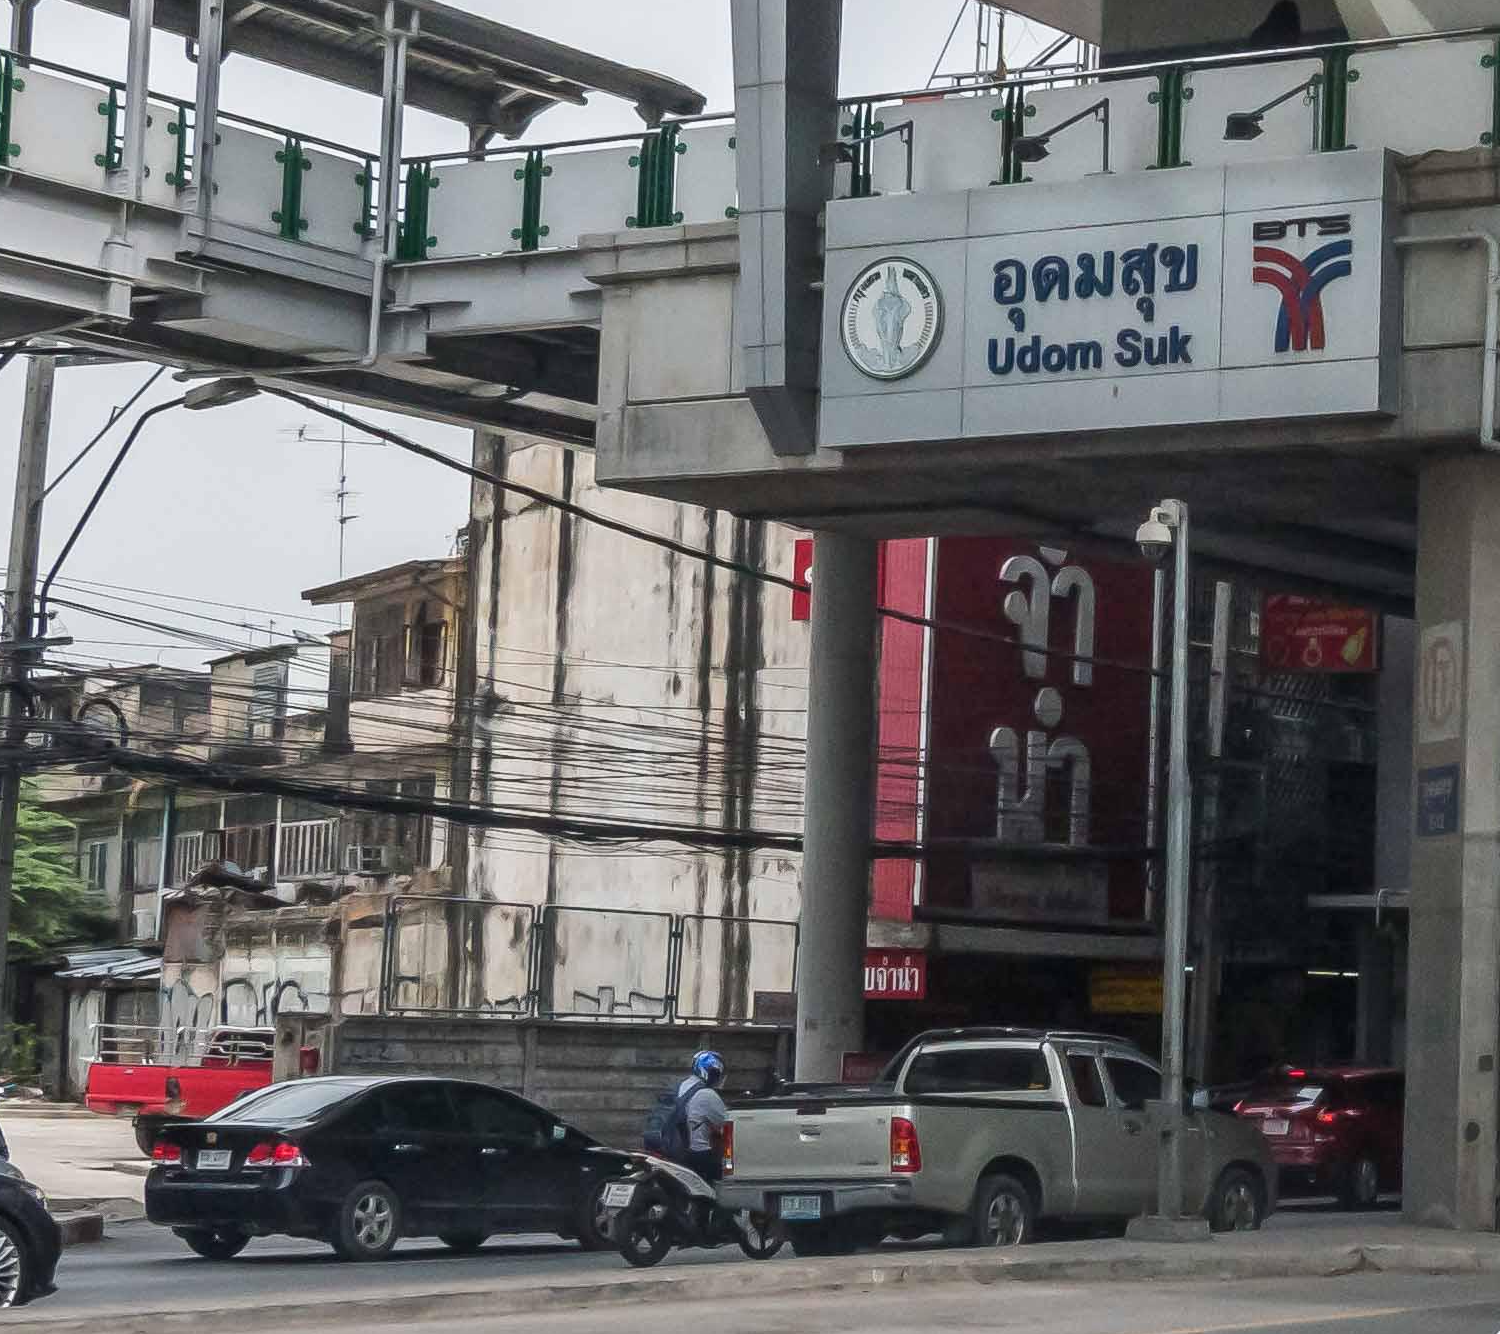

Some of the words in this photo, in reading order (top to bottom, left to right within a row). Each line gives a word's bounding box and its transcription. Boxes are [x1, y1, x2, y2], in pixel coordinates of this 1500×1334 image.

[1253, 214, 1351, 241] BTS
[993, 243, 1198, 332] อุดมสุข
[988, 335, 1103, 375] Udom
[1114, 325, 1193, 367] Suk
